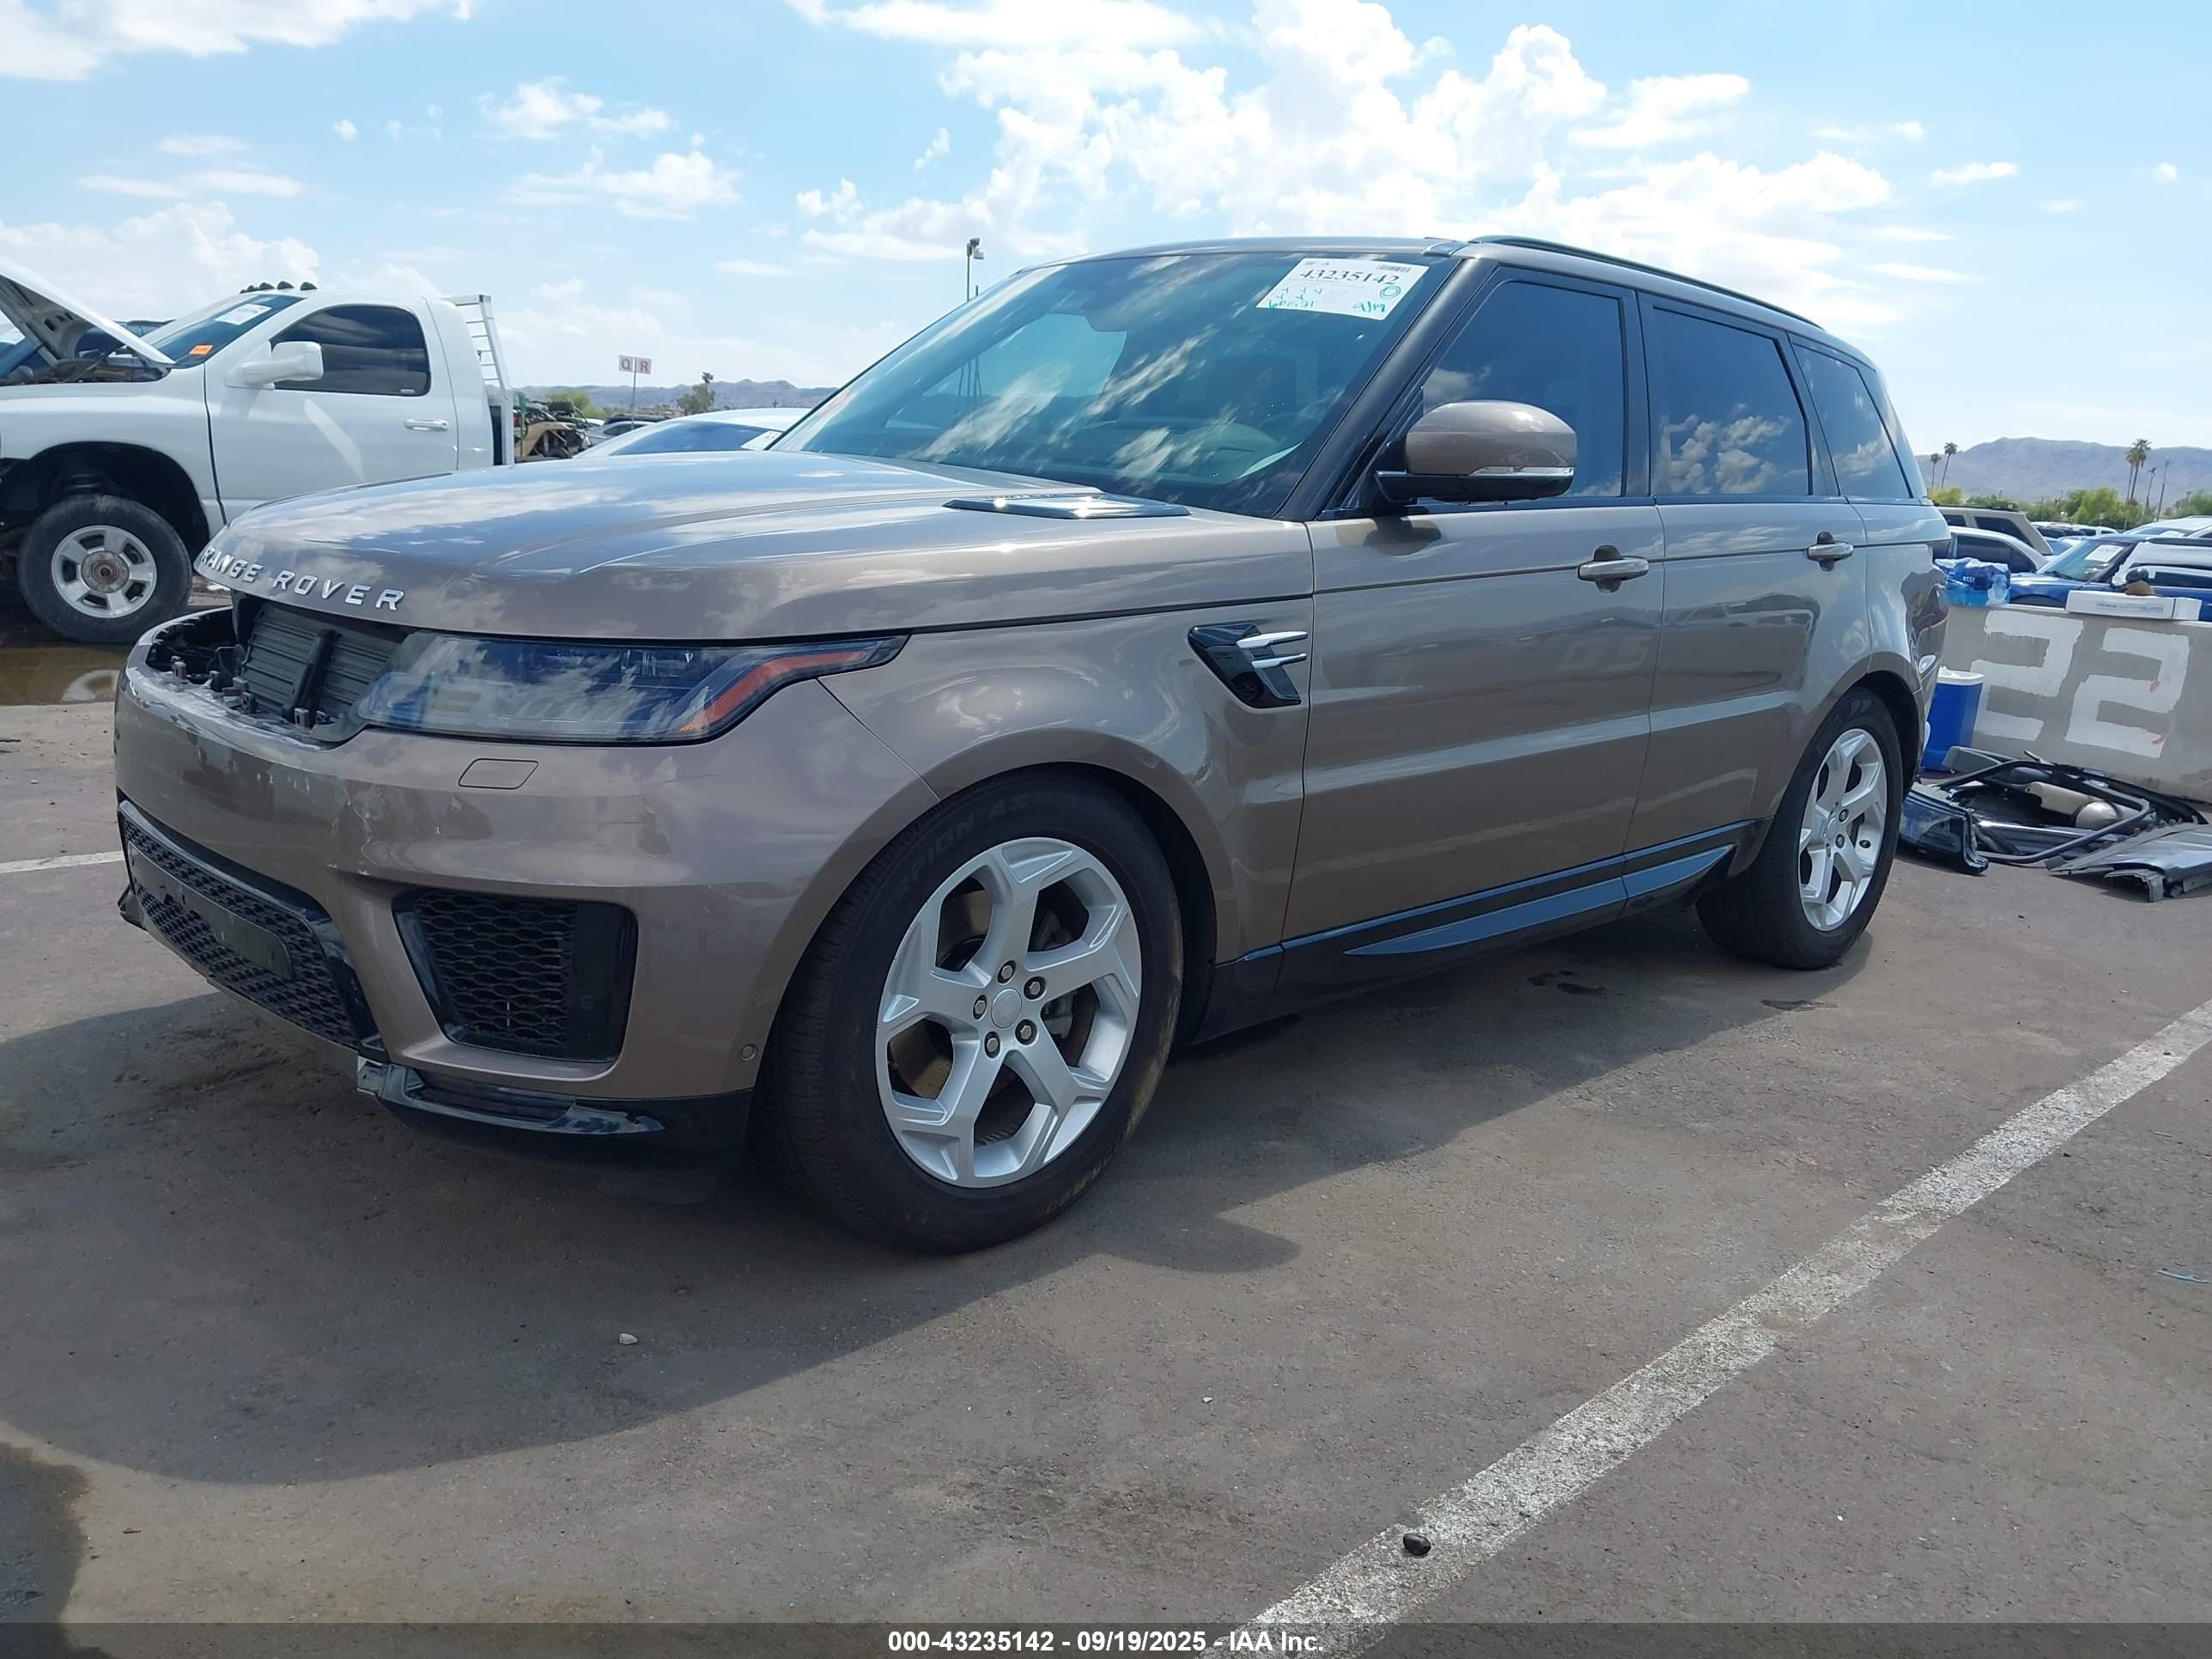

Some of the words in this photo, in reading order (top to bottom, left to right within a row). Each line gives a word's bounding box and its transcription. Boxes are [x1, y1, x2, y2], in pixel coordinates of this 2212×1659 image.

[1299, 269, 1400, 285] 43235142
[641, 360, 648, 371] R
[201, 548, 264, 583] RANGE
[272, 569, 404, 611] ROVER
